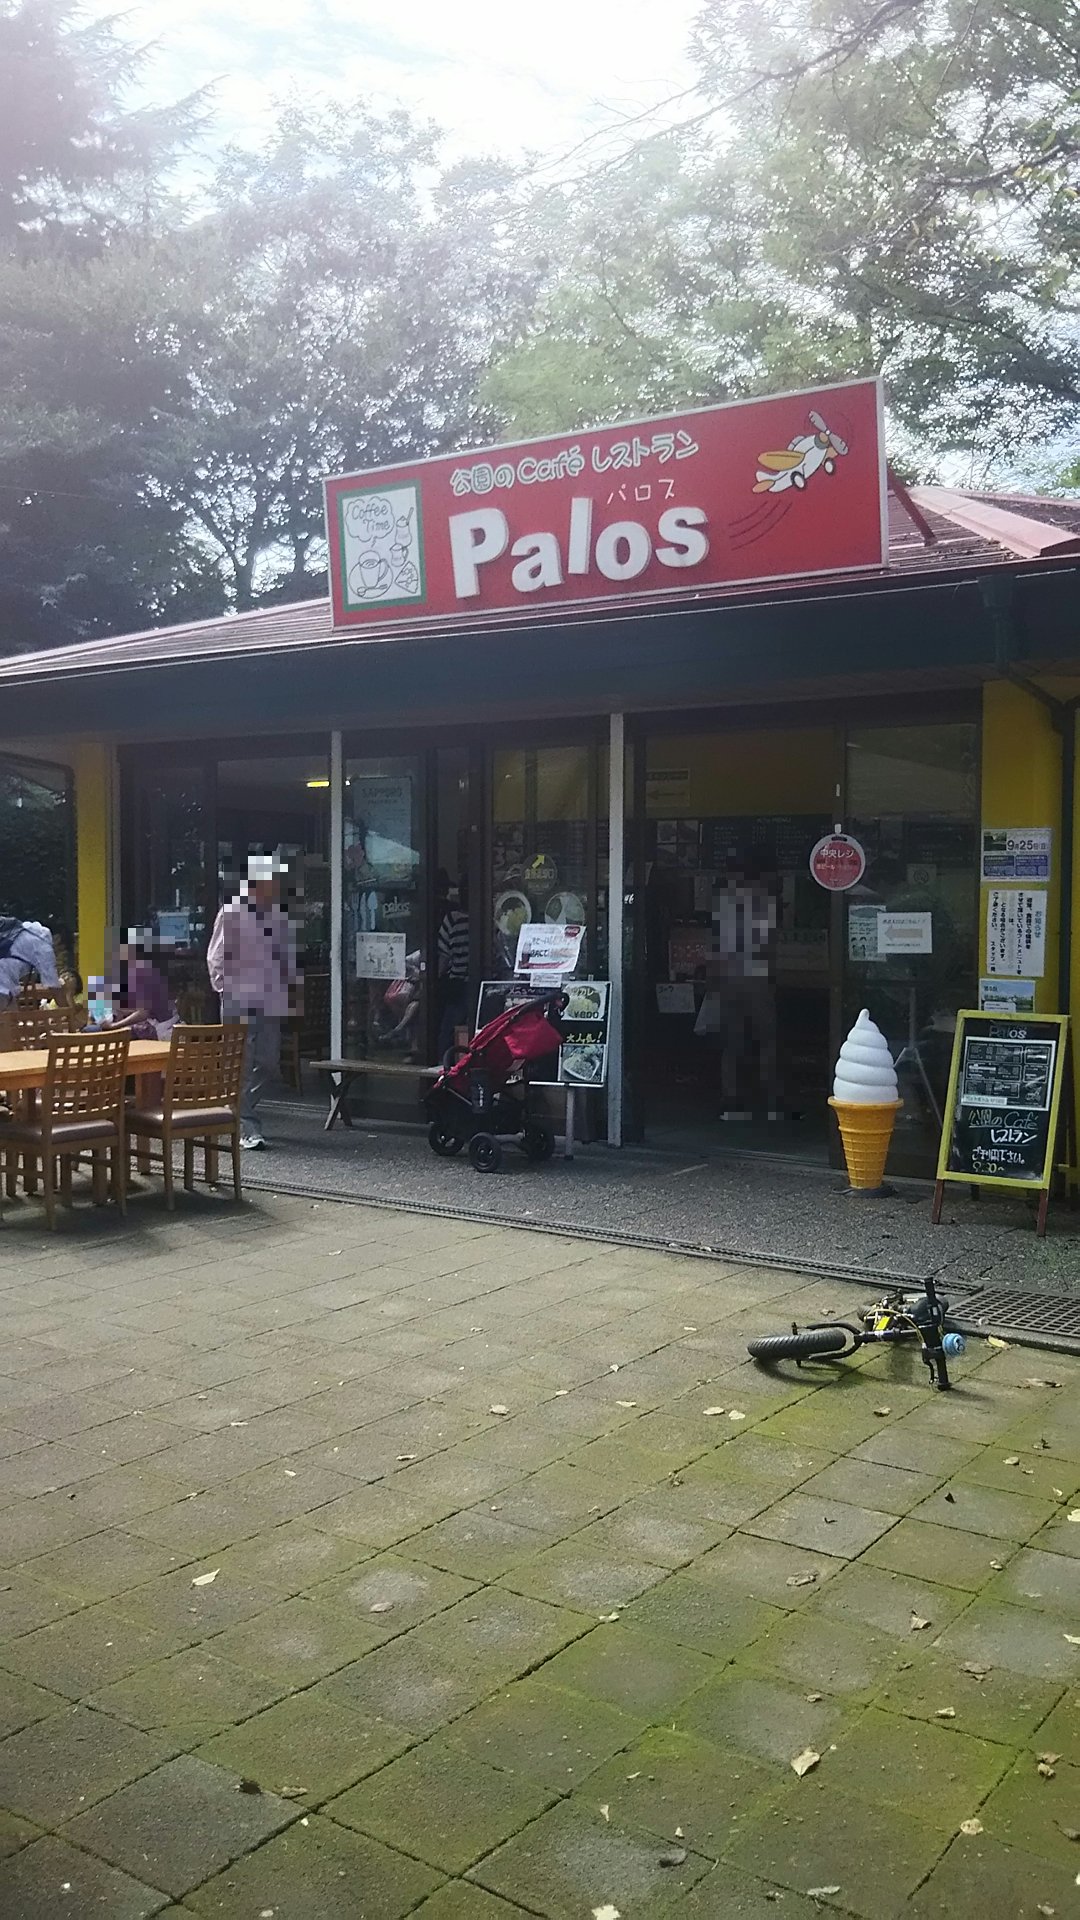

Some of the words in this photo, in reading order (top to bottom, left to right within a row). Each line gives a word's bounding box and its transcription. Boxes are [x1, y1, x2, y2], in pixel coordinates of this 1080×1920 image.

[592, 430, 699, 473] レストラン
[351, 503, 388, 520] Coffee
[362, 518, 390, 533] Time
[448, 497, 710, 600] Palos
[990, 1128, 1038, 1144] レストラン
